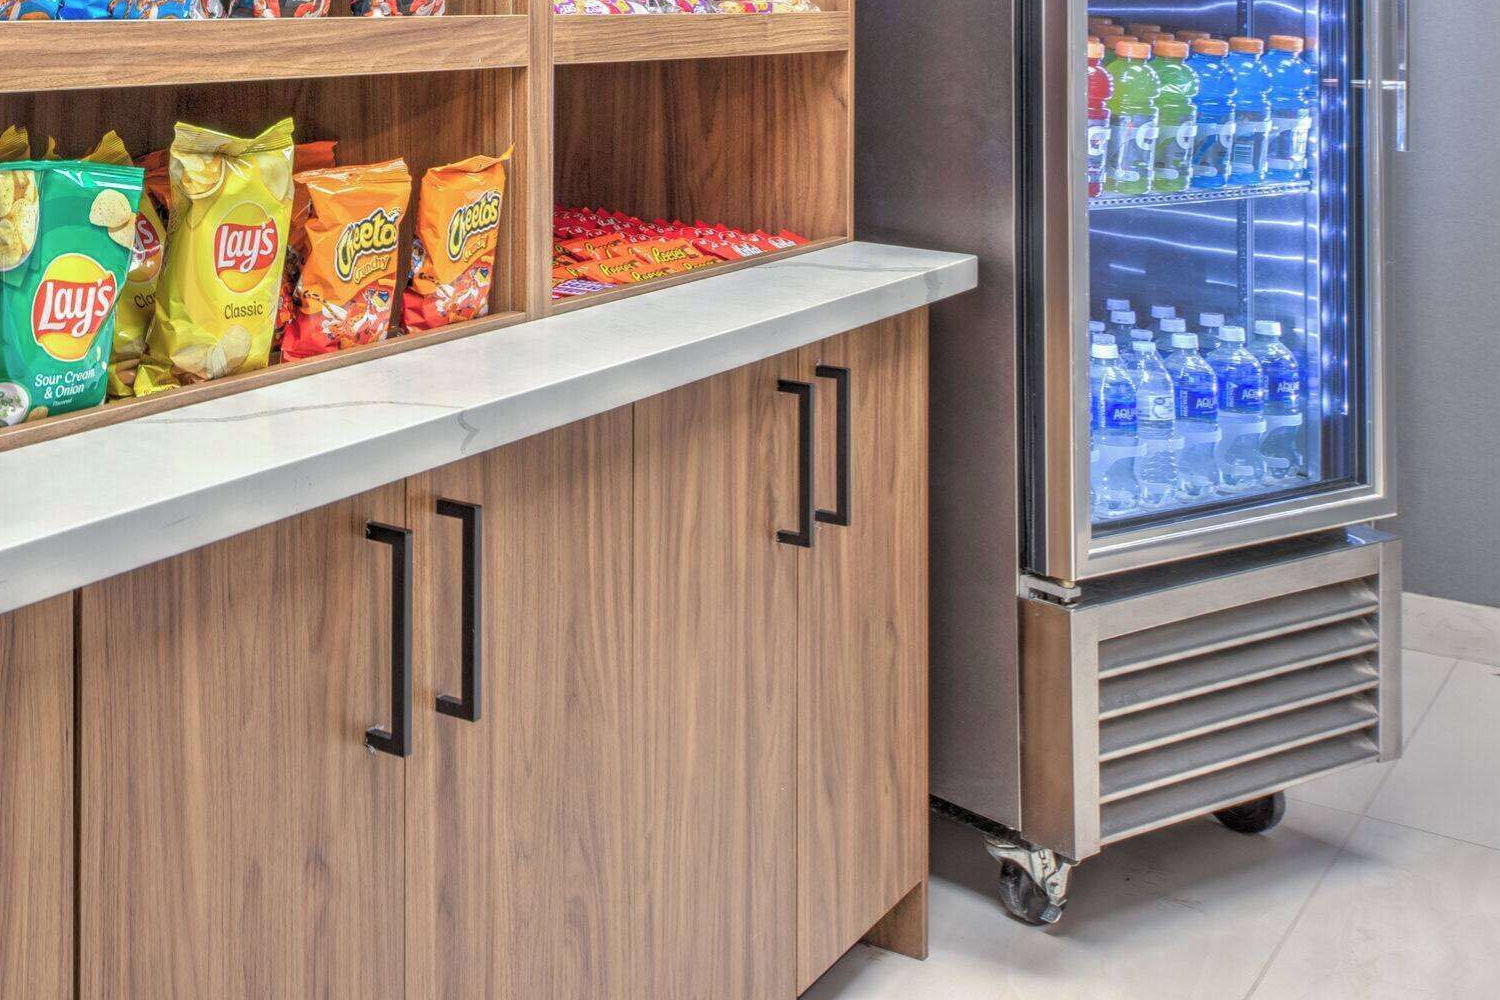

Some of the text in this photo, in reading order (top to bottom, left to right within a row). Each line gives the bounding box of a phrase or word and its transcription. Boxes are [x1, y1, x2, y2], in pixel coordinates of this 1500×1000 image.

[217, 222, 276, 274] Lay's
[336, 209, 399, 280] Cheeto
[447, 190, 502, 262] Cheetos
[37, 279, 115, 338] Lay's
[224, 300, 263, 321] Classic
[34, 367, 95, 387] Sour Cream
[43, 382, 85, 399] & Onion
